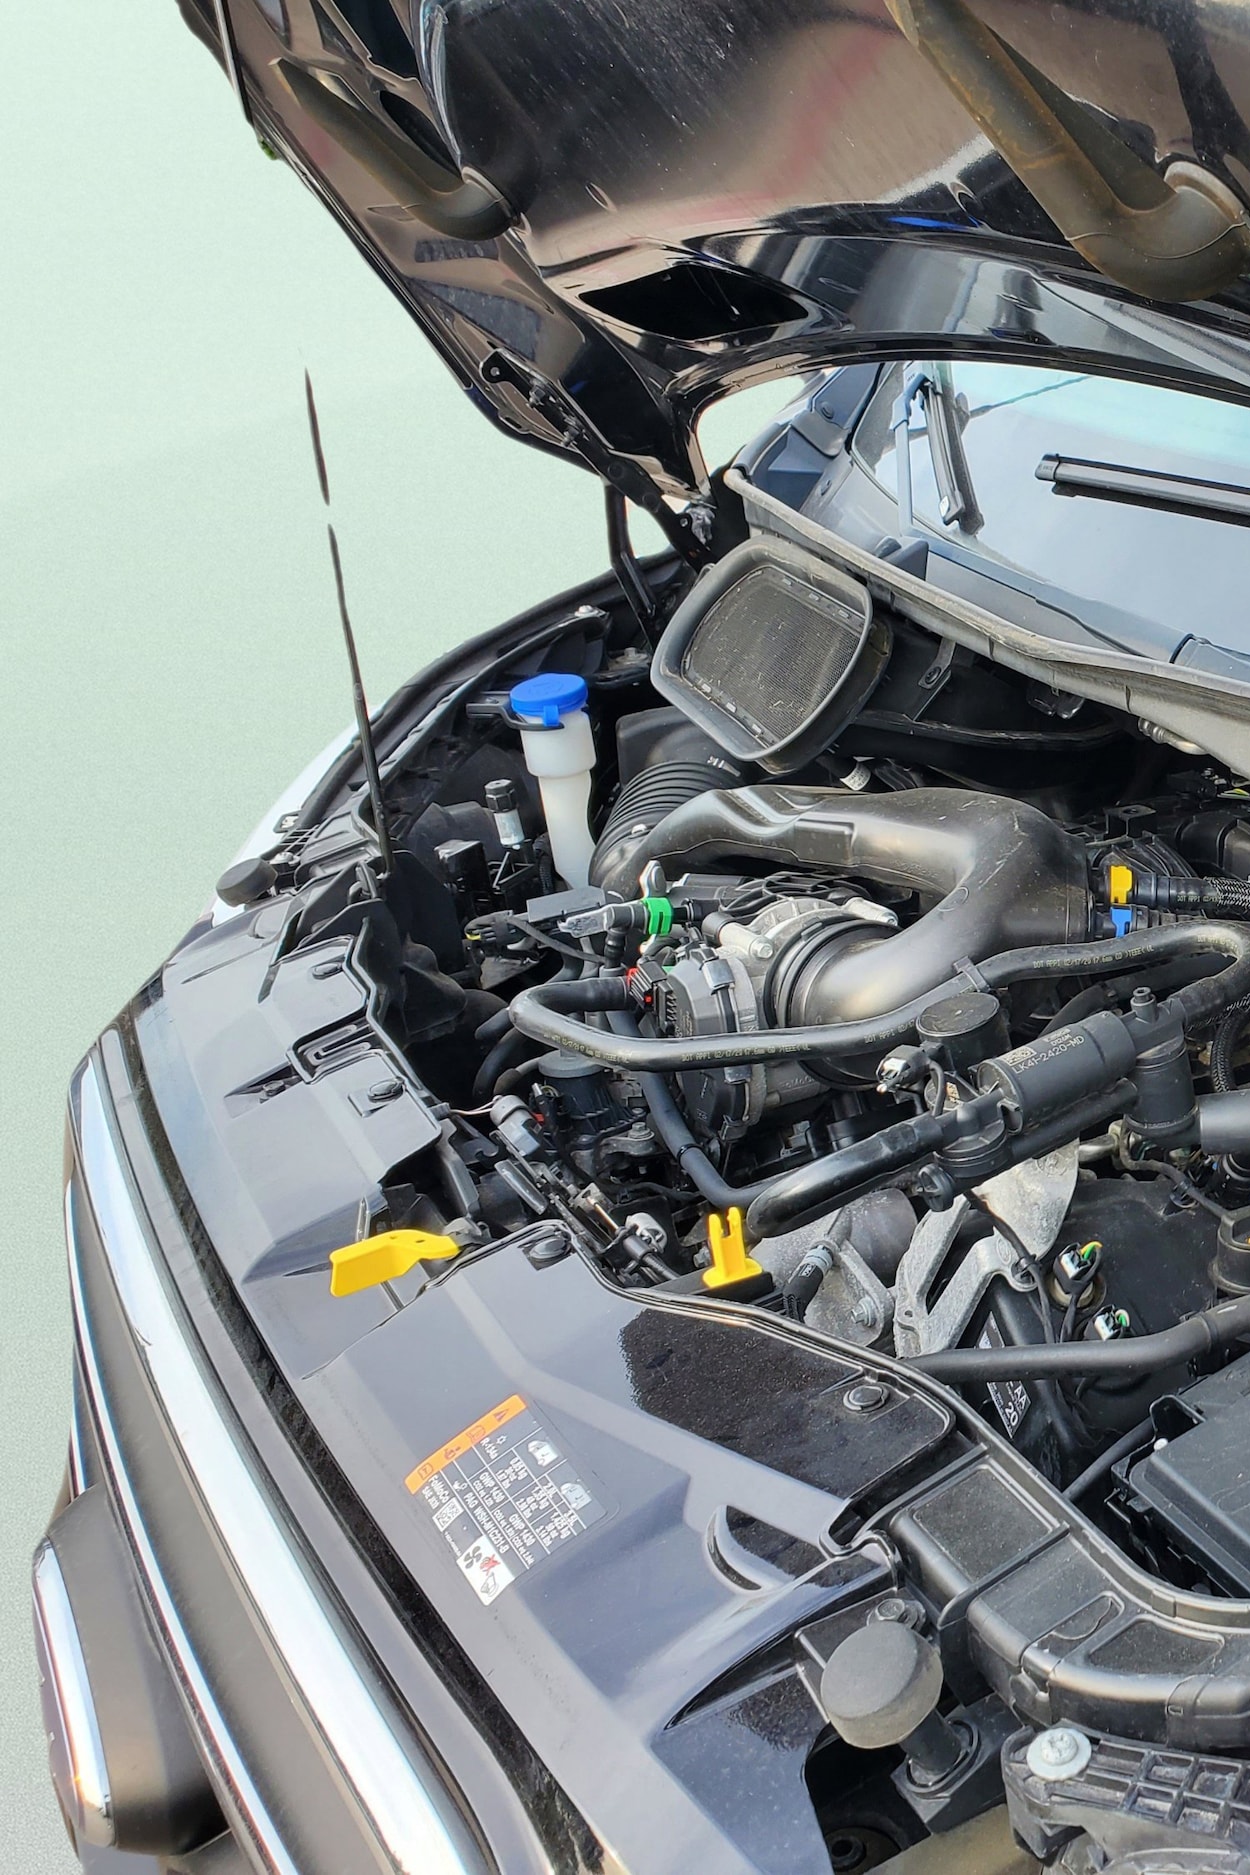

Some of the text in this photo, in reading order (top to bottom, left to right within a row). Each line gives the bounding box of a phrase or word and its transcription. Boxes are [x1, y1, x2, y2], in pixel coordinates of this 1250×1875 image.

[1005, 1401, 1019, 1426] 20
[478, 1471, 505, 1503] GWP 1430
[462, 1491, 478, 1508] PAG
[508, 1512, 525, 1533] GWP
